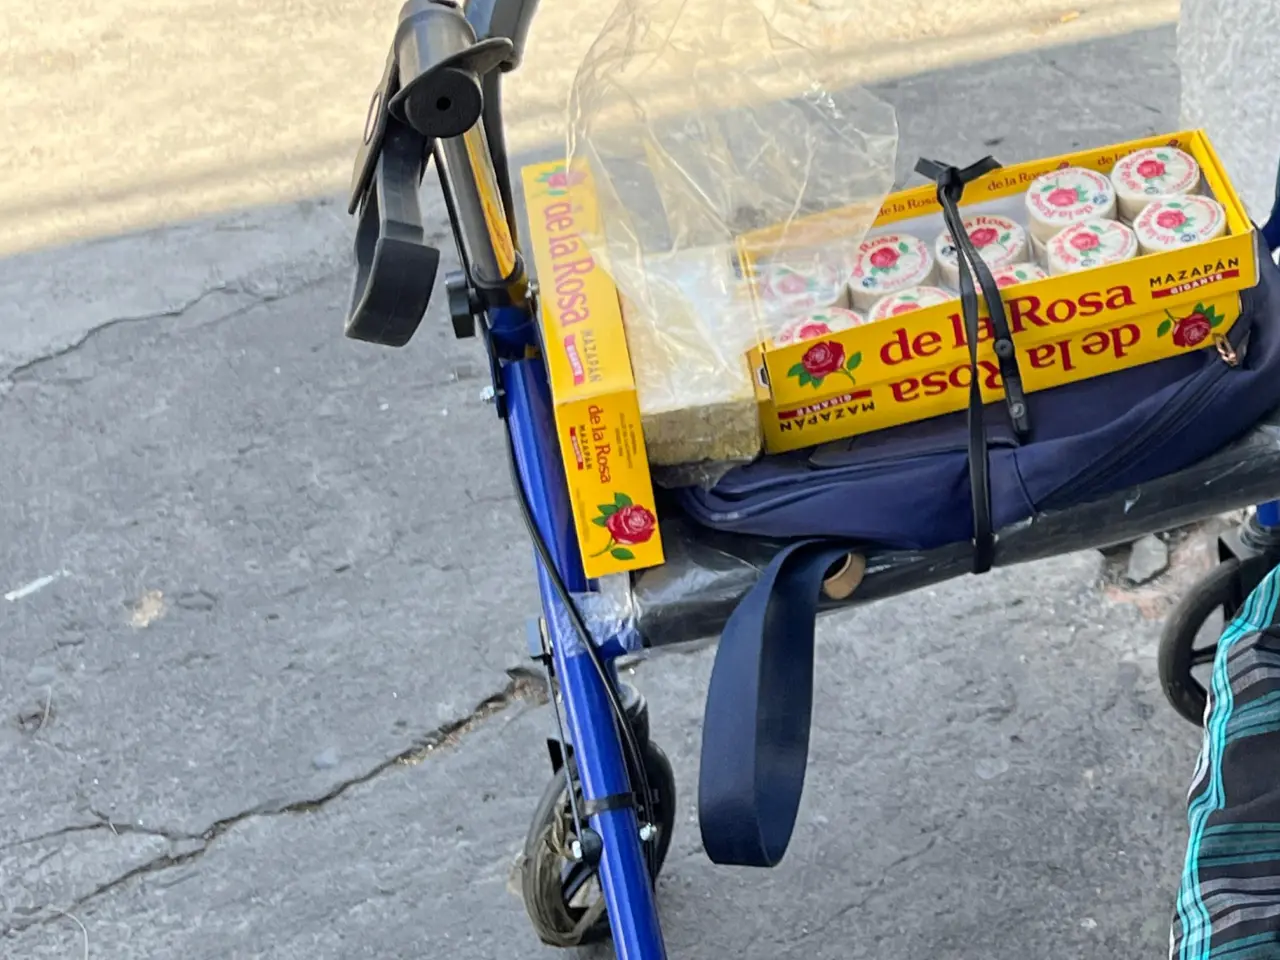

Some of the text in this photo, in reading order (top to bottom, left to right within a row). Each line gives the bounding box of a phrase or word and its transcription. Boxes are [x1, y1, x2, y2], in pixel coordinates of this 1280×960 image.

[544, 201, 597, 328] de la Rosa
[1149, 257, 1240, 288] MAZAPÁN
[879, 285, 1136, 366] de la Rosa
[1025, 323, 1141, 372] de la
[588, 404, 611, 484] de la Rosa
[780, 401, 875, 432] MAZAPÁN
